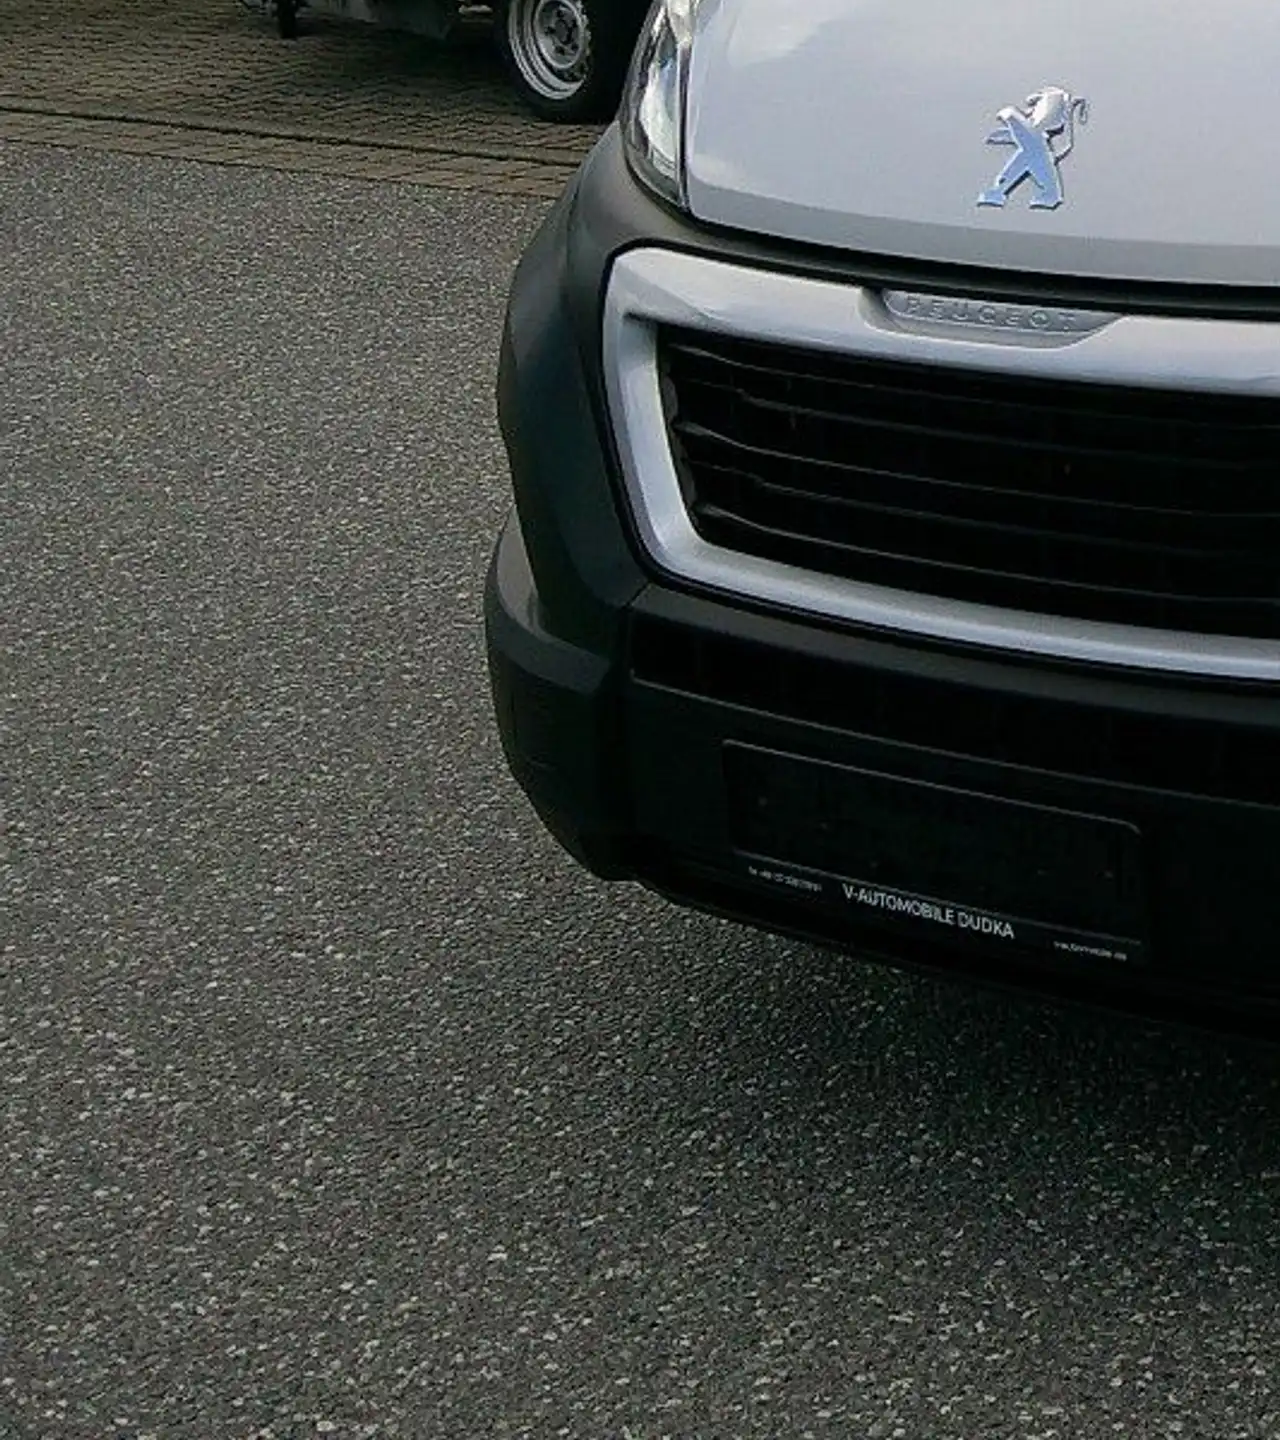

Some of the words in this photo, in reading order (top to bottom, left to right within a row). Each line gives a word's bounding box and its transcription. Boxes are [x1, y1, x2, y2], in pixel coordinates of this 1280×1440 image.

[906, 294, 1077, 330] PEUGEOT
[842, 882, 955, 926] V-AUTOMOBILE
[957, 910, 1016, 941] DUDKA
